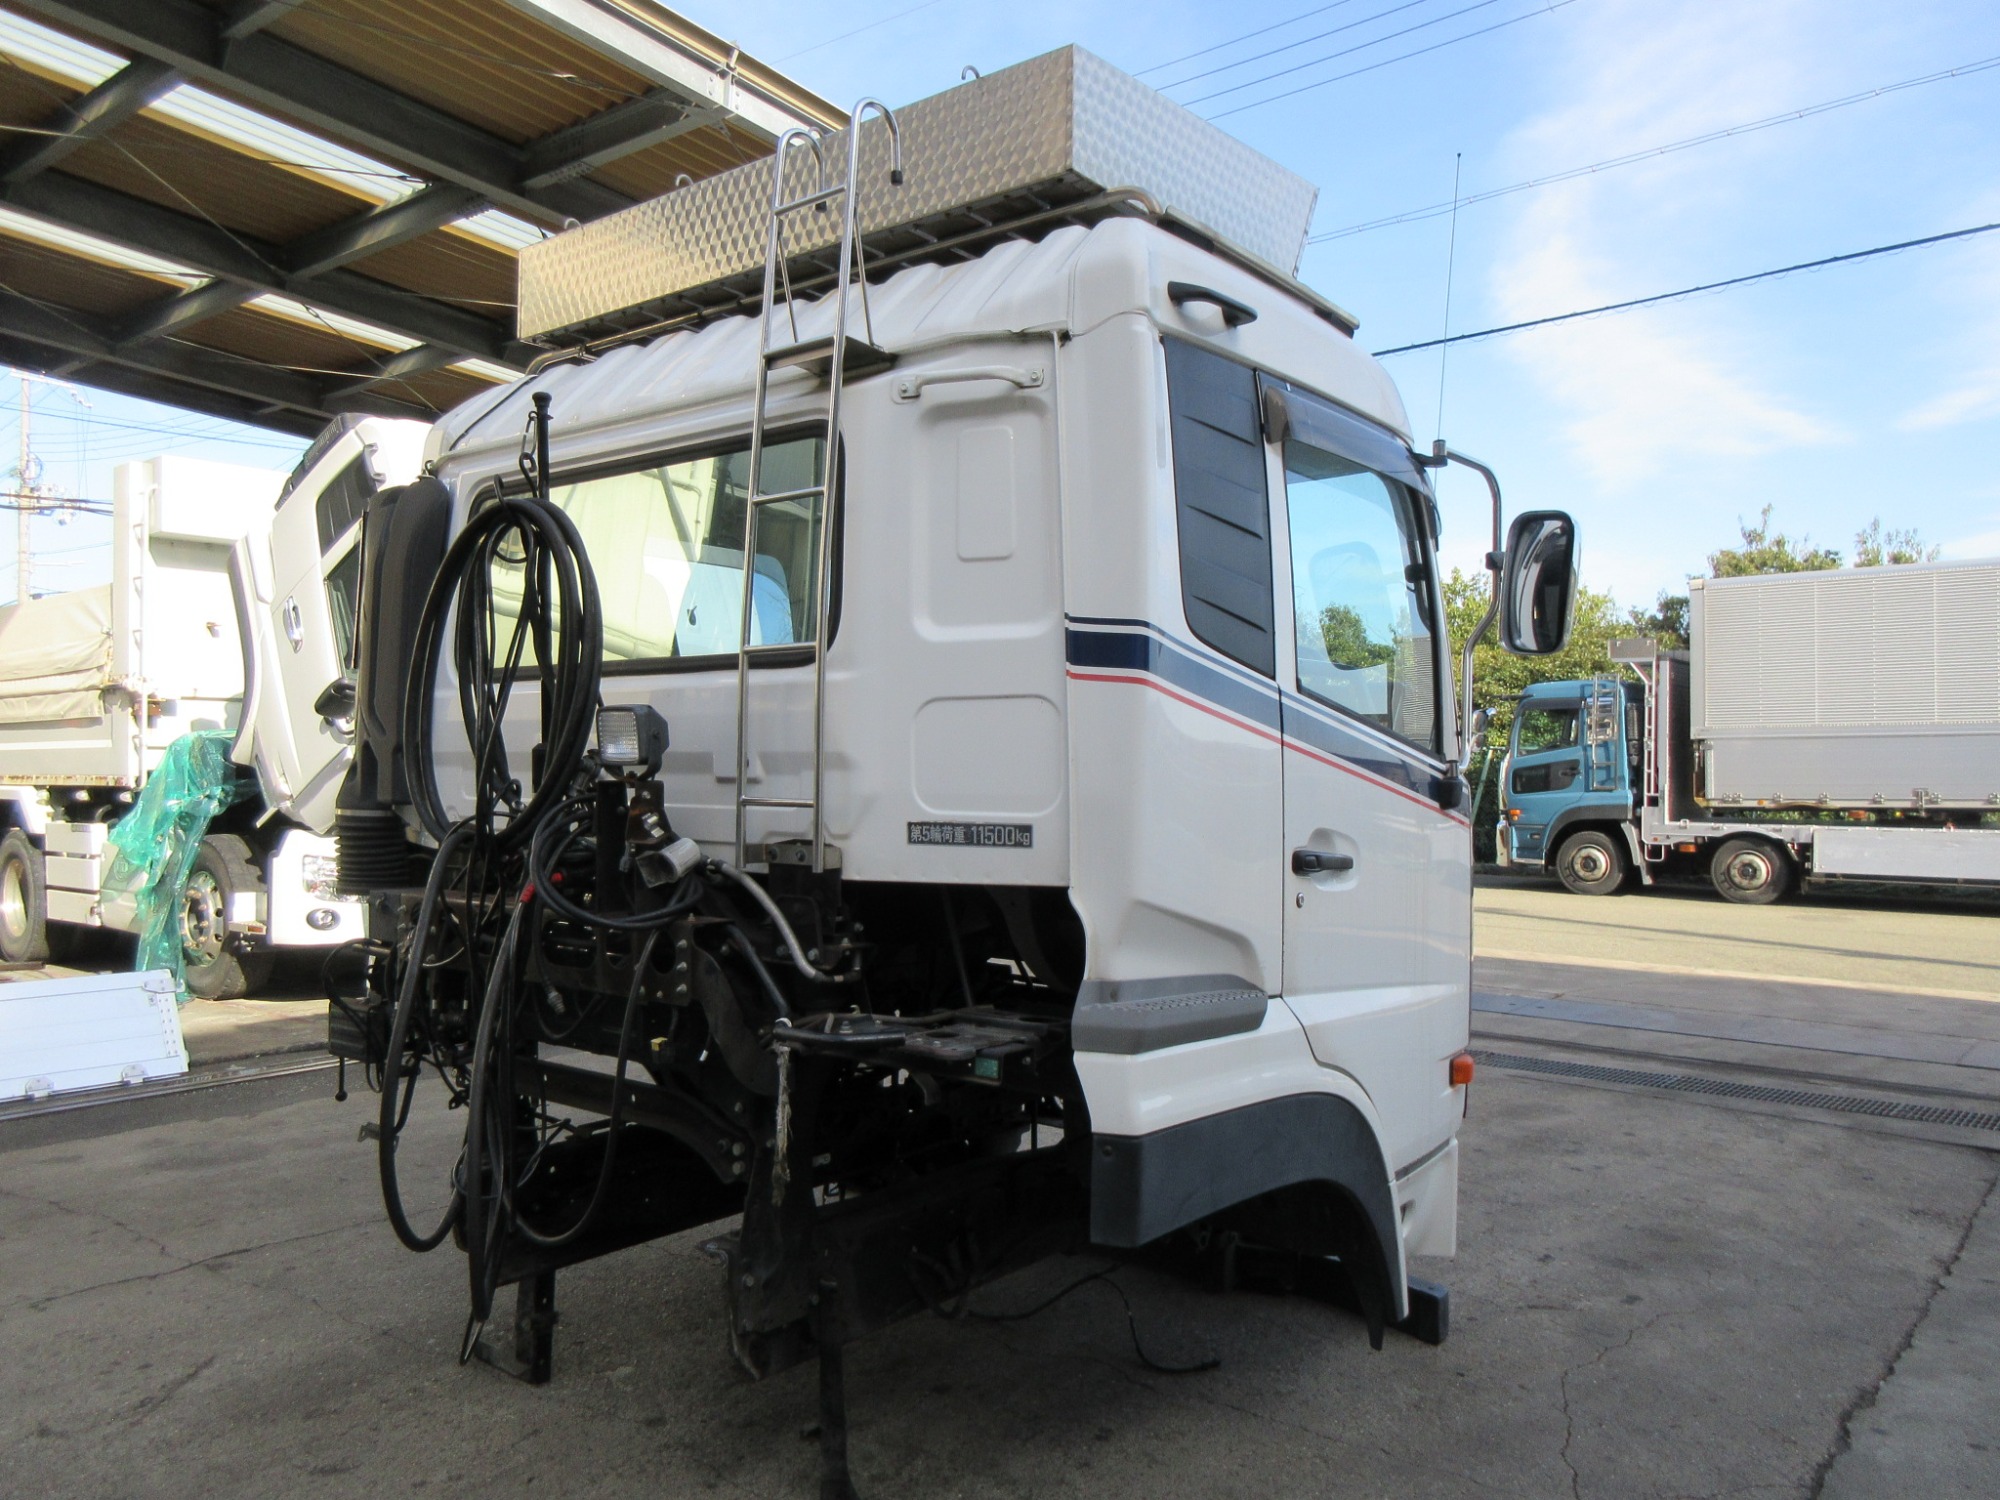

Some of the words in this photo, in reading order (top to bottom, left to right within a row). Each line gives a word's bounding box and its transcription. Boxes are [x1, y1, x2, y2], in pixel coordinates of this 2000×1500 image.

[910, 824, 966, 843] 第5輪荷重
[971, 826, 1031, 845] 11500kg
